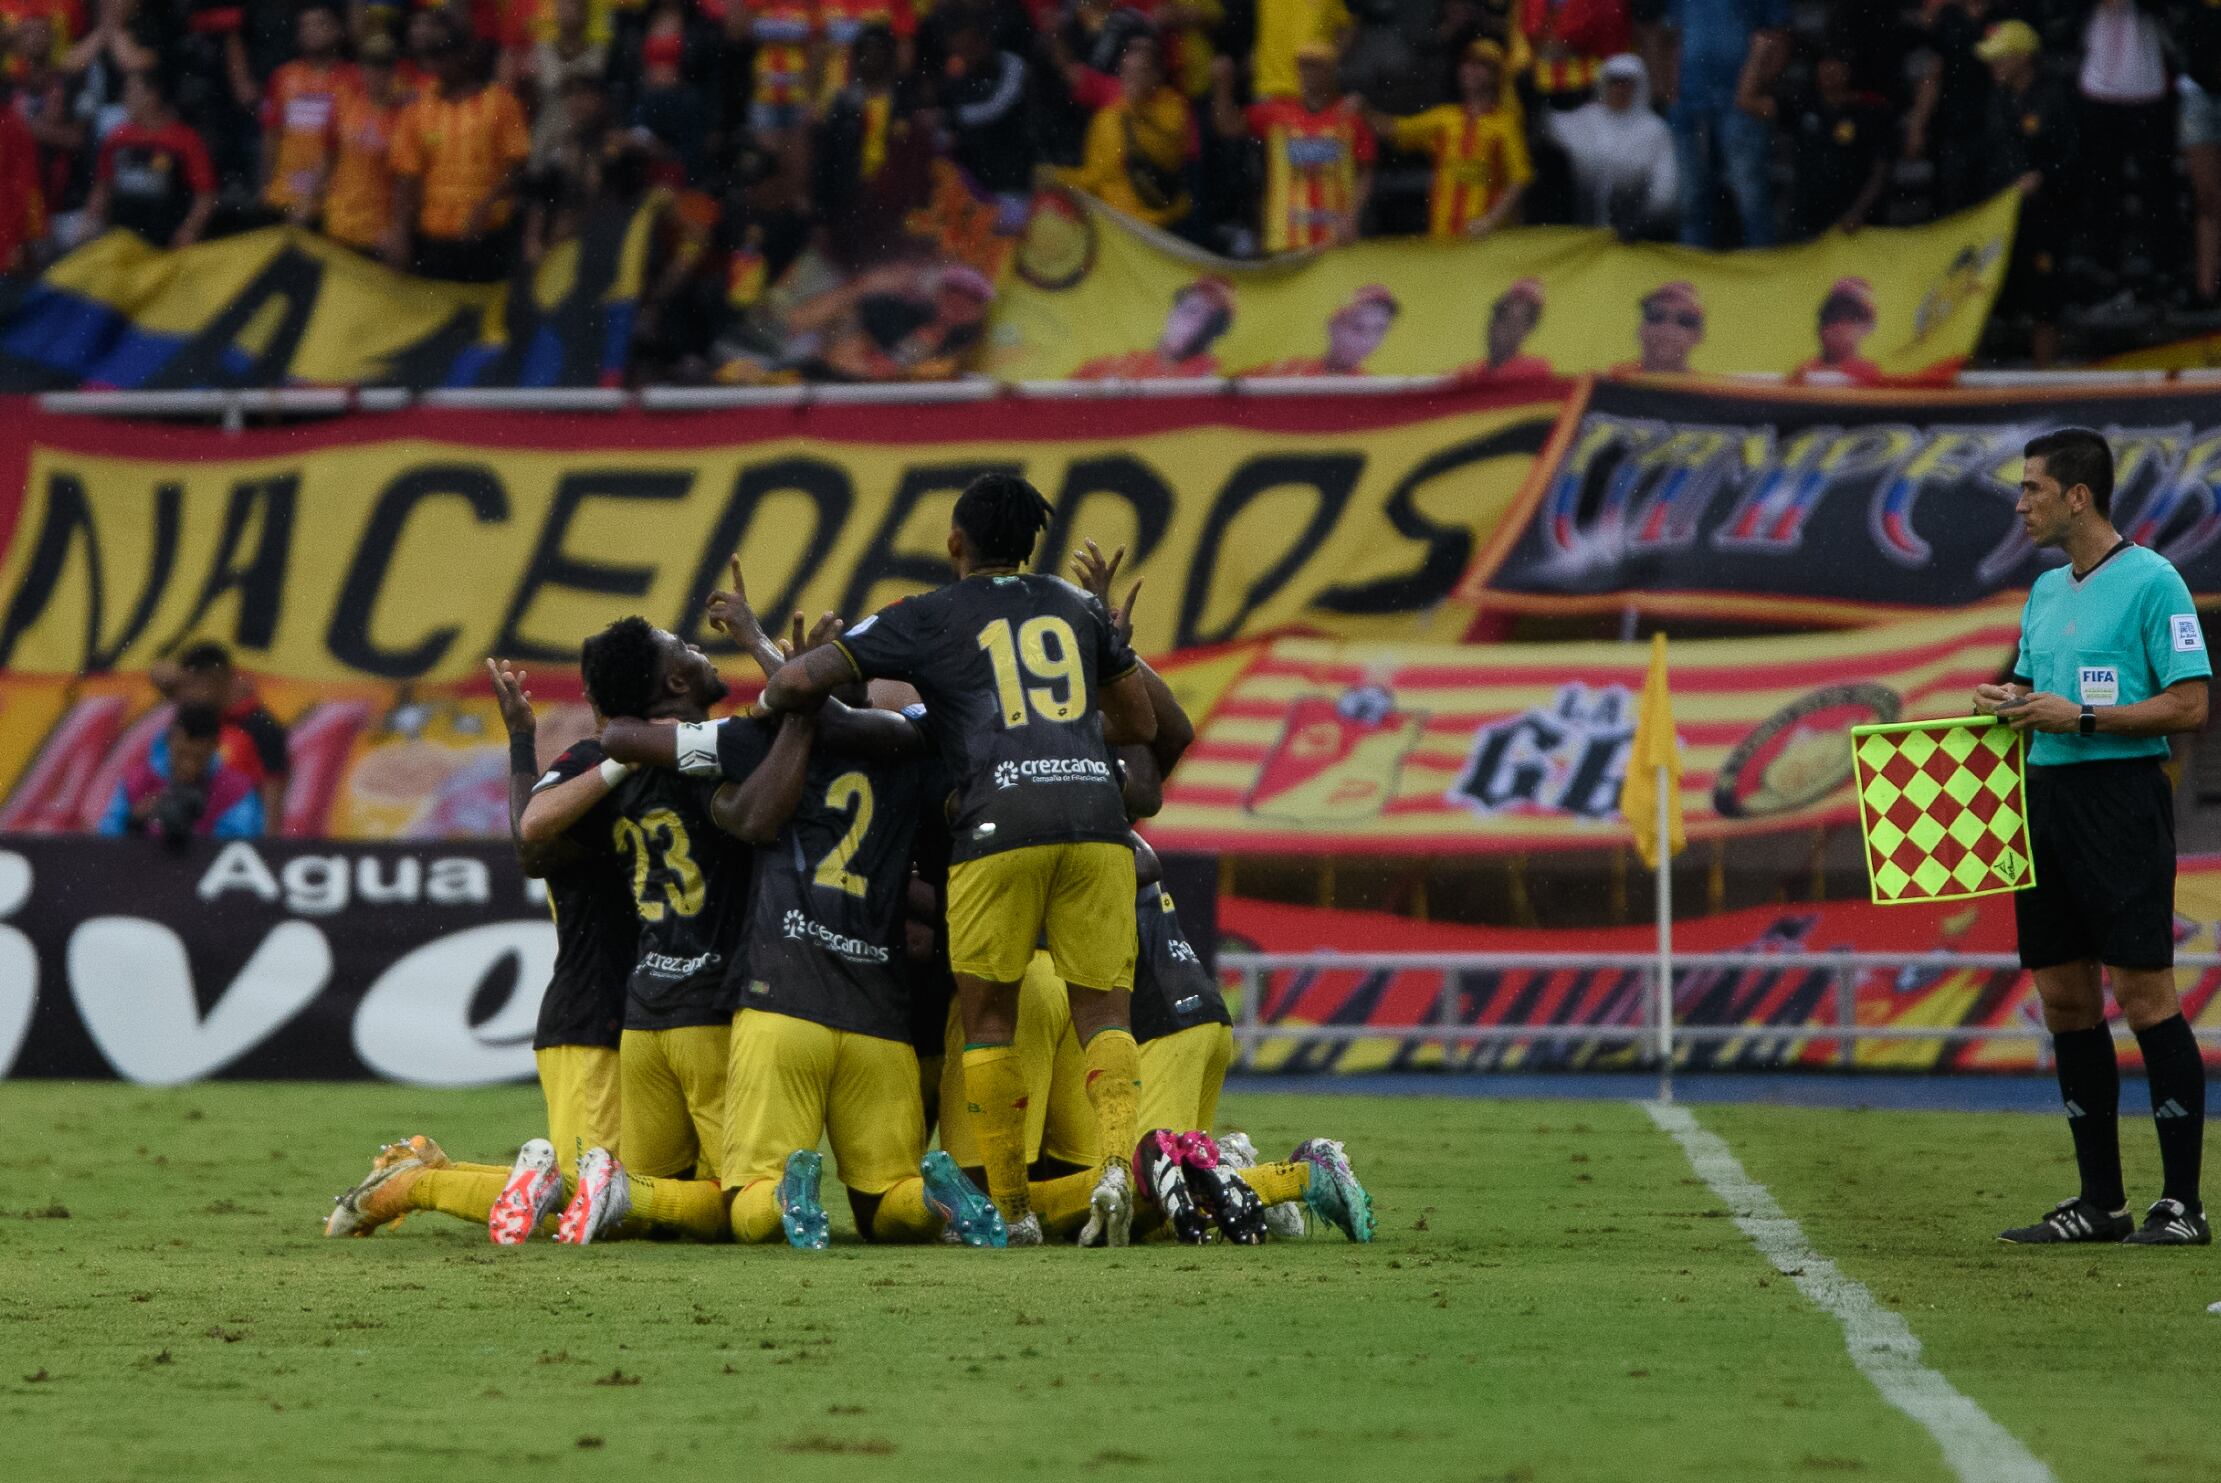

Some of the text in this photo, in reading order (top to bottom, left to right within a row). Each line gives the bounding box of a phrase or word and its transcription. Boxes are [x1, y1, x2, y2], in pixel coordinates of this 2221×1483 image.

[976, 615, 1087, 729] 19
[2083, 670, 2115, 682] FIFA
[198, 841, 490, 915] Agua
[613, 807, 706, 922] 23
[812, 771, 874, 897] 2
